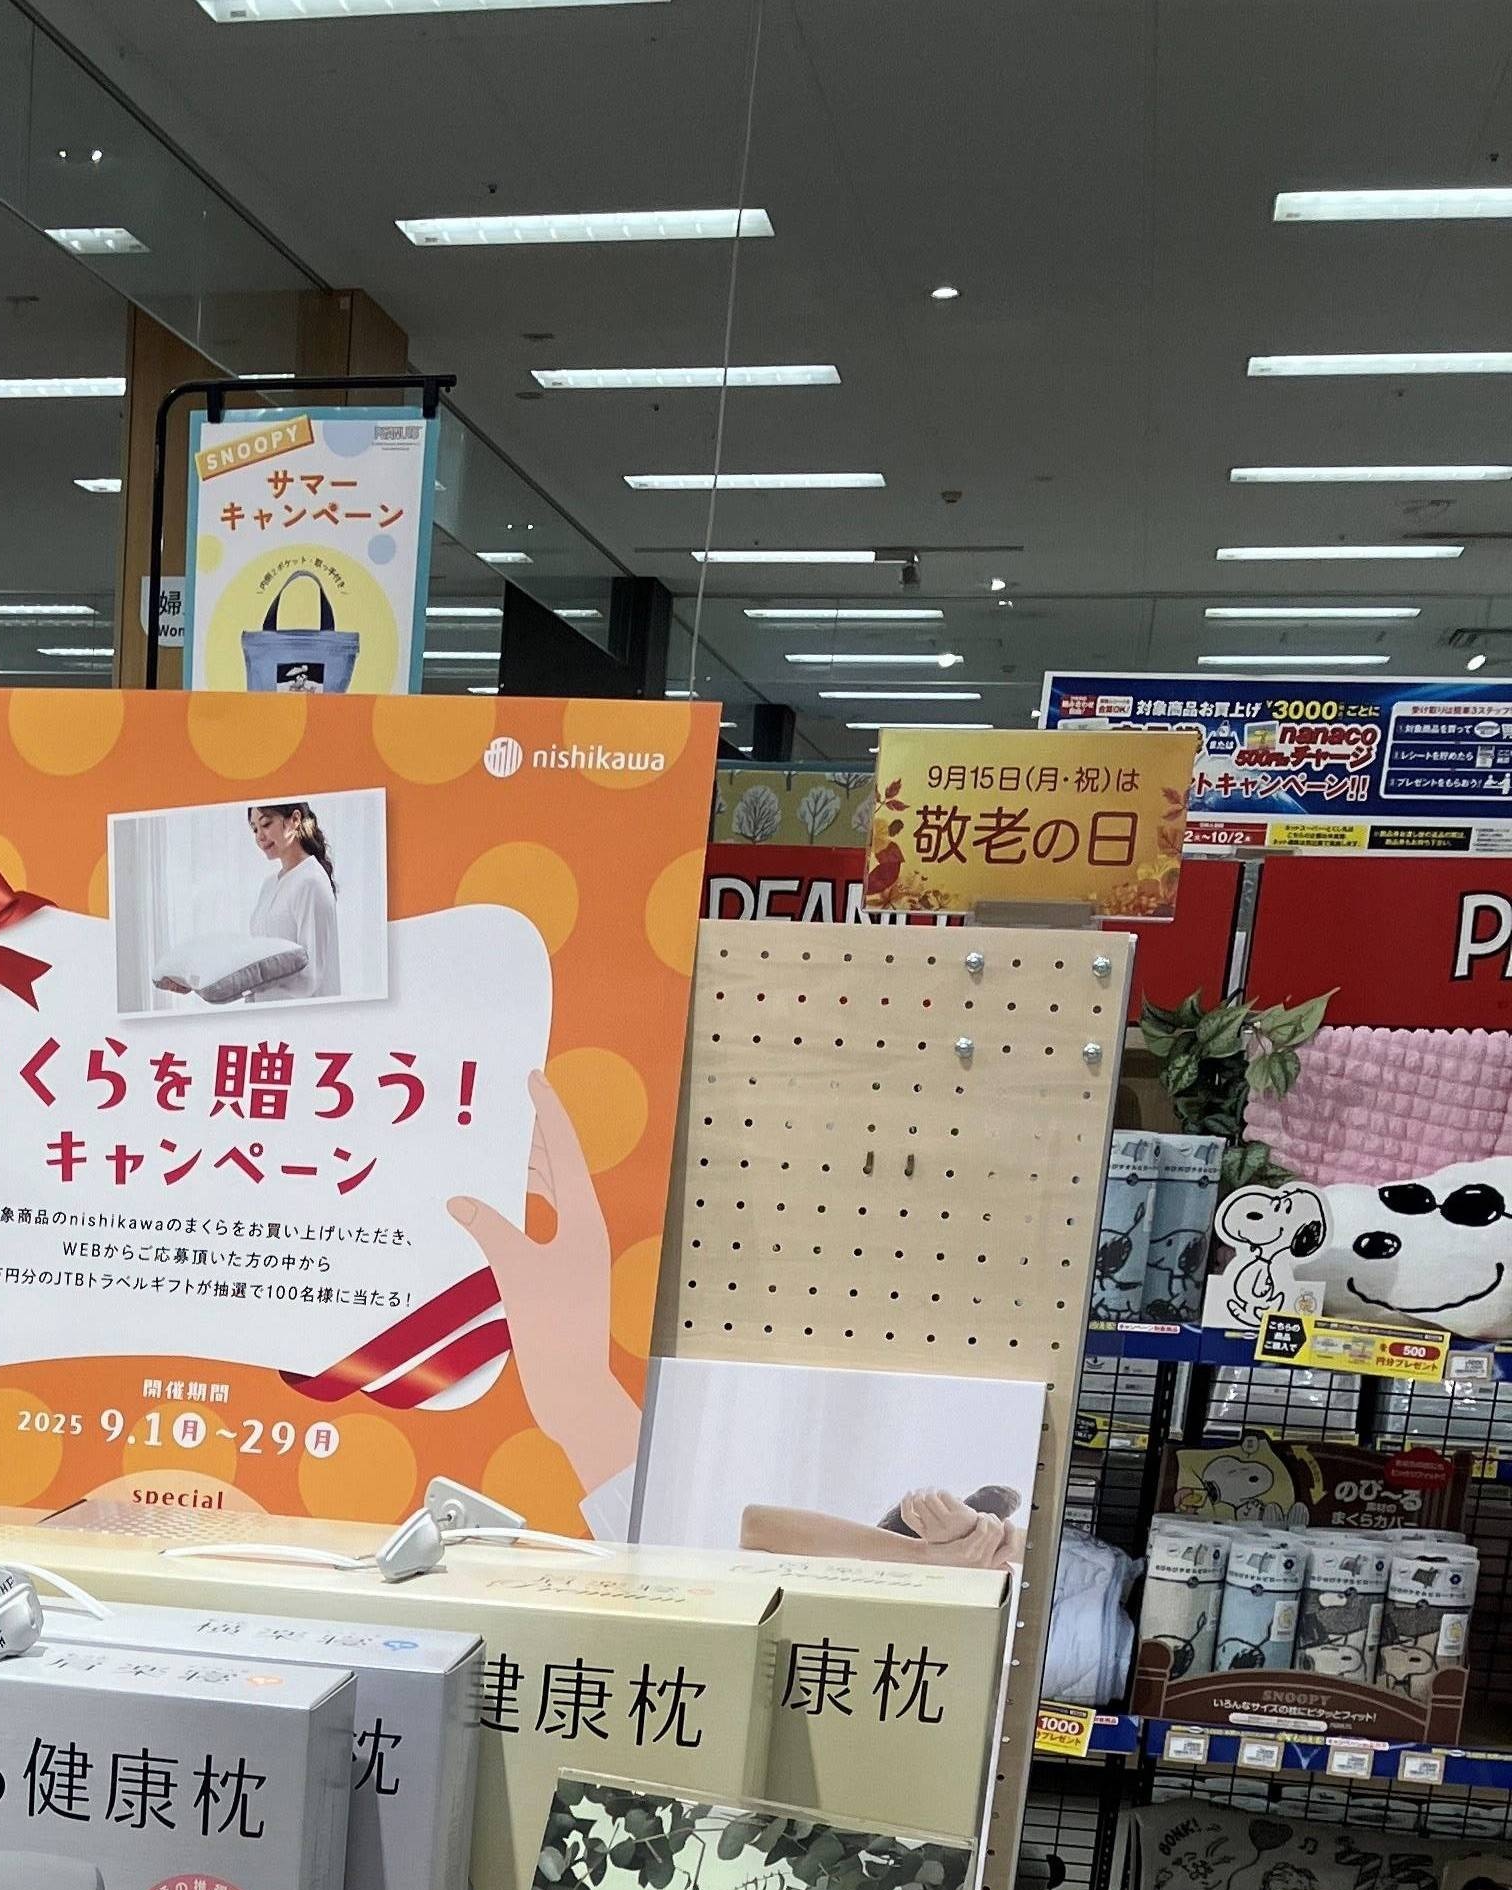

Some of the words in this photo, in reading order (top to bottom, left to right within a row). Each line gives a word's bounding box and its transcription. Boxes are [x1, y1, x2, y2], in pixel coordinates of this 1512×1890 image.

[206, 425, 299, 470] SNOOPY
[268, 470, 357, 499] サマー
[220, 502, 404, 530] キャンペーン
[1279, 723, 1377, 746] nanaco
[531, 744, 666, 775] nishikawa
[914, 805, 1139, 867] 敬老の日
[45, 1131, 380, 1196] キャンペーン
[62, 1241, 331, 1273] WEBからご応募頂いた方の中から
[1402, 1345, 1426, 1358] 500
[142, 1379, 229, 1404] 開催期間
[17, 1410, 83, 1436] 2025
[1331, 1512, 1419, 1528] まくらカバー
[1262, 1689, 1331, 1705] SNOOPY
[1041, 1716, 1080, 1734] 1000
